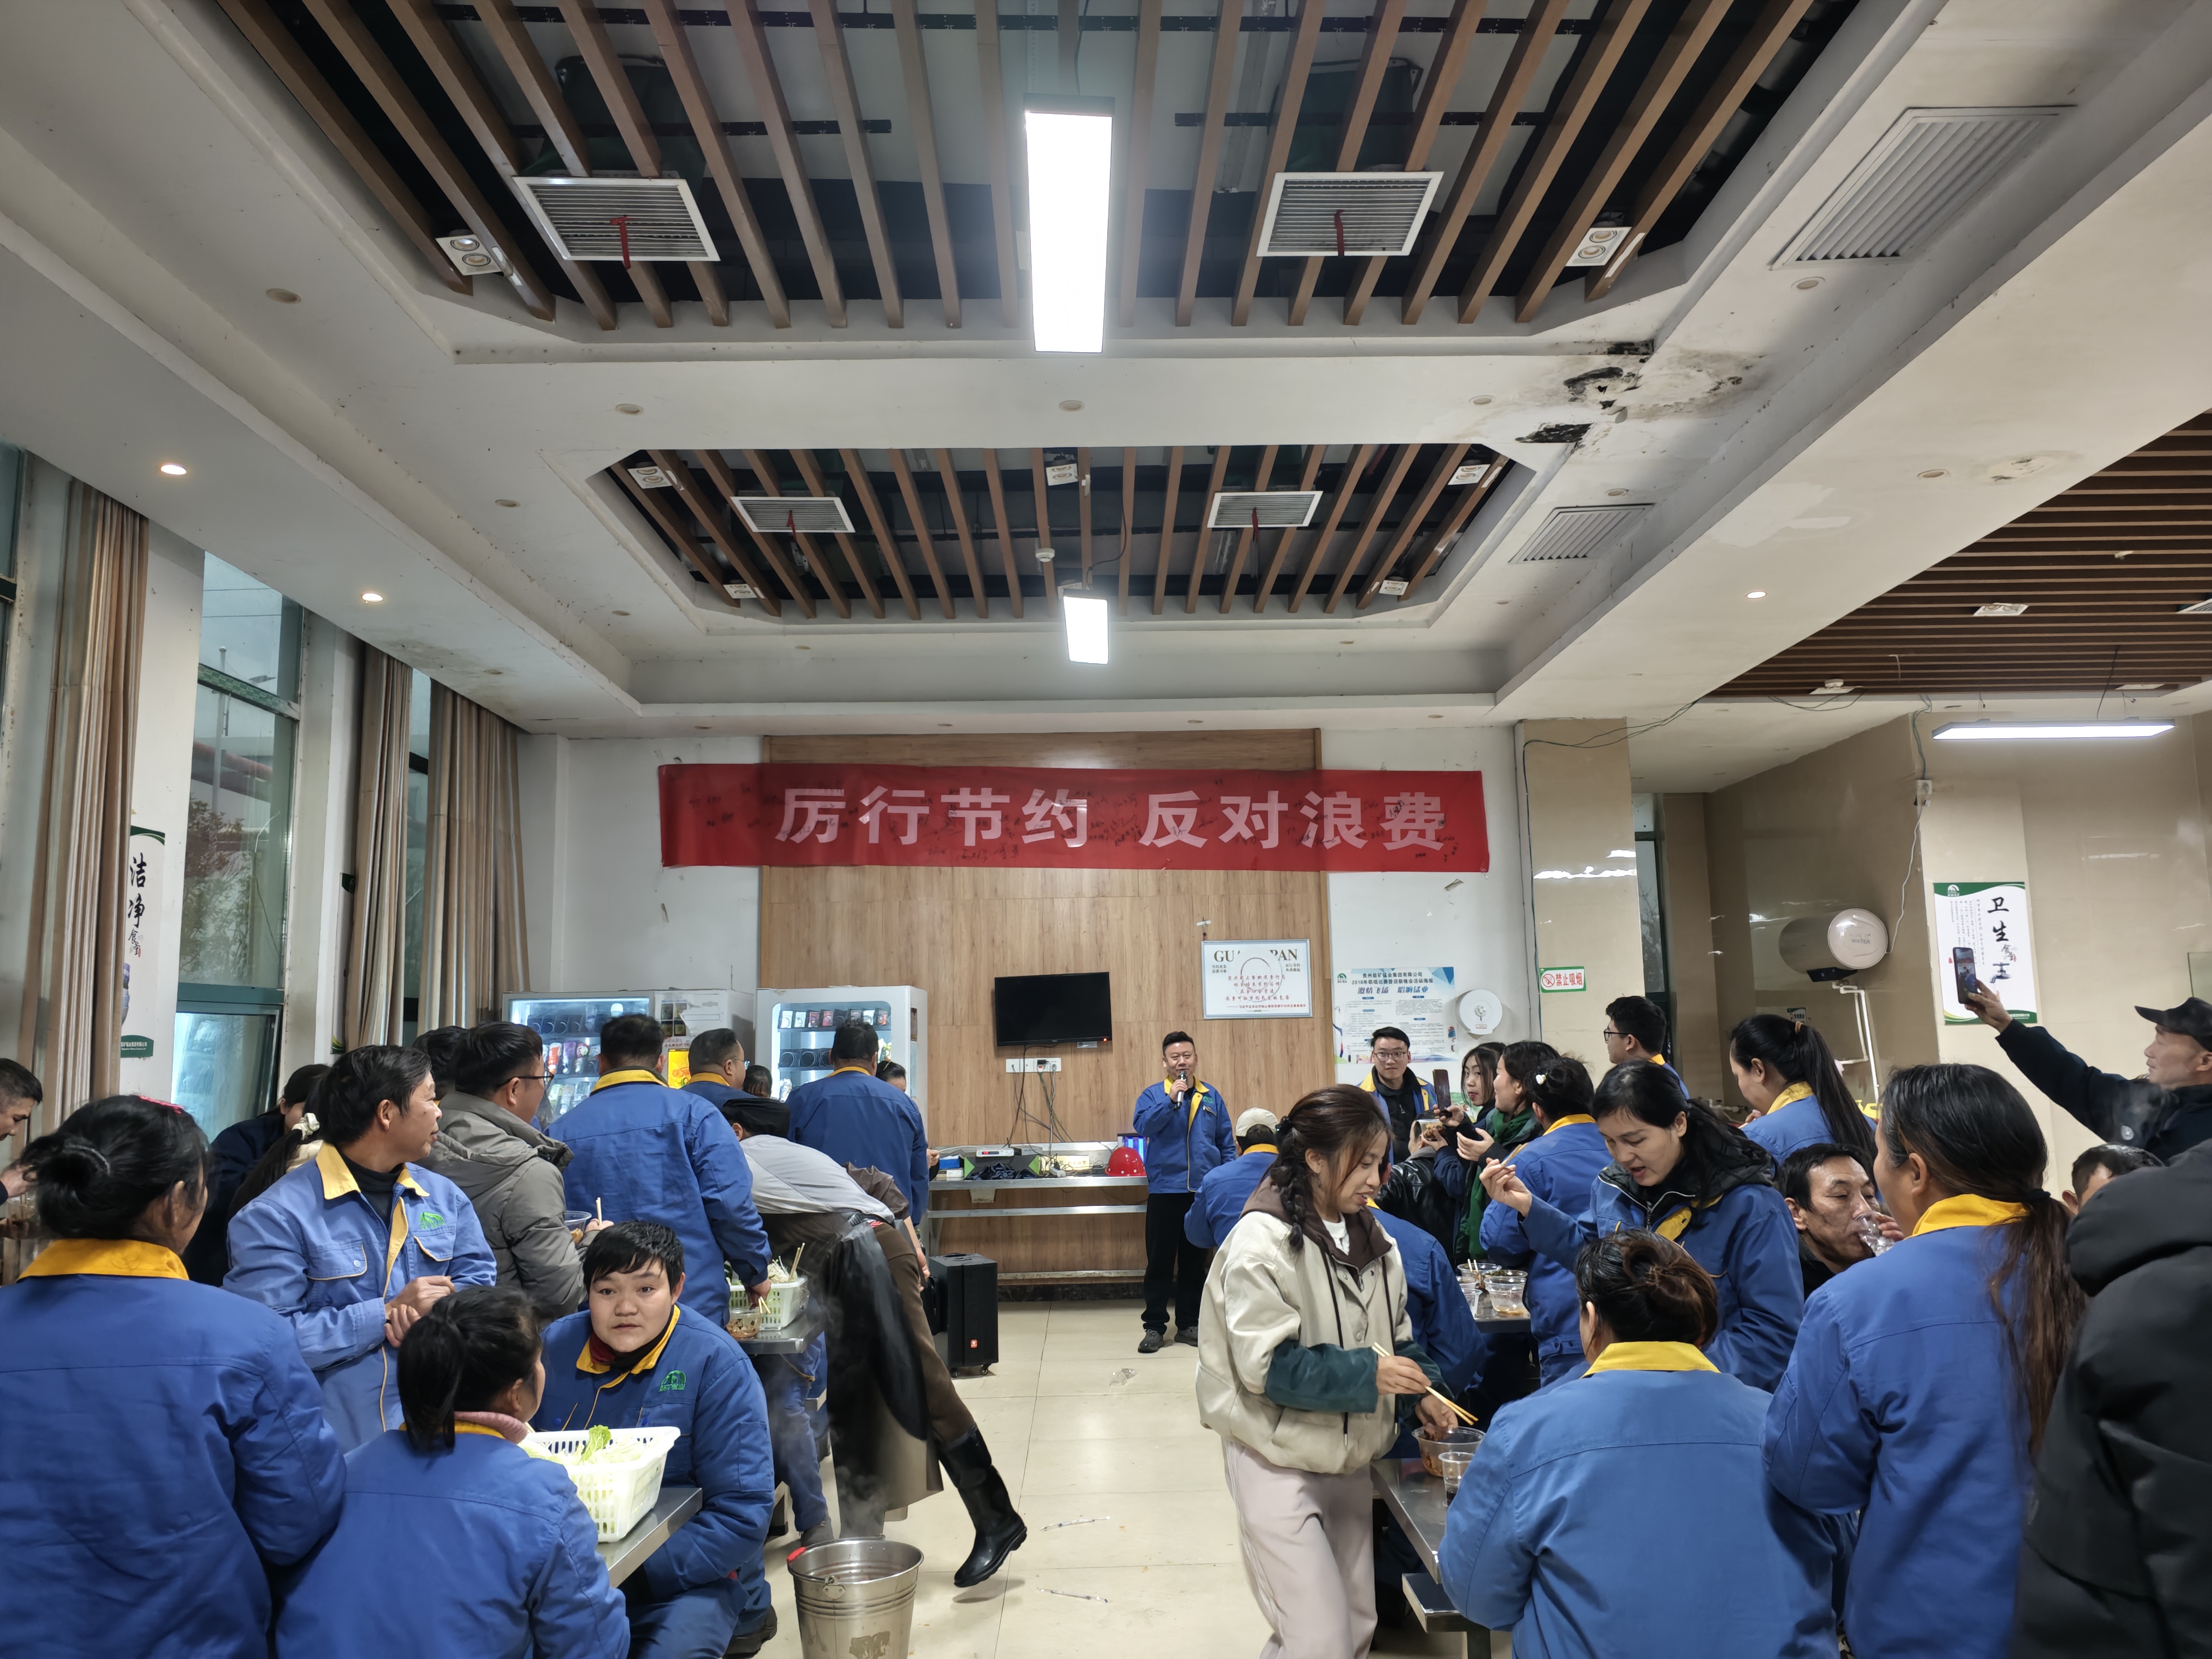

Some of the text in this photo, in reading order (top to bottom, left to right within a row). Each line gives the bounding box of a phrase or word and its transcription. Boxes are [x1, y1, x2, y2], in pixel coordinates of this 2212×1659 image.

[774, 786, 1088, 848] 厉行节约
[1138, 790, 1446, 851] 反对浪费
[128, 852, 147, 928] 洁净
[1987, 896, 2009, 942] 卫生
[1556, 973, 1583, 987] 禁止吸烟
